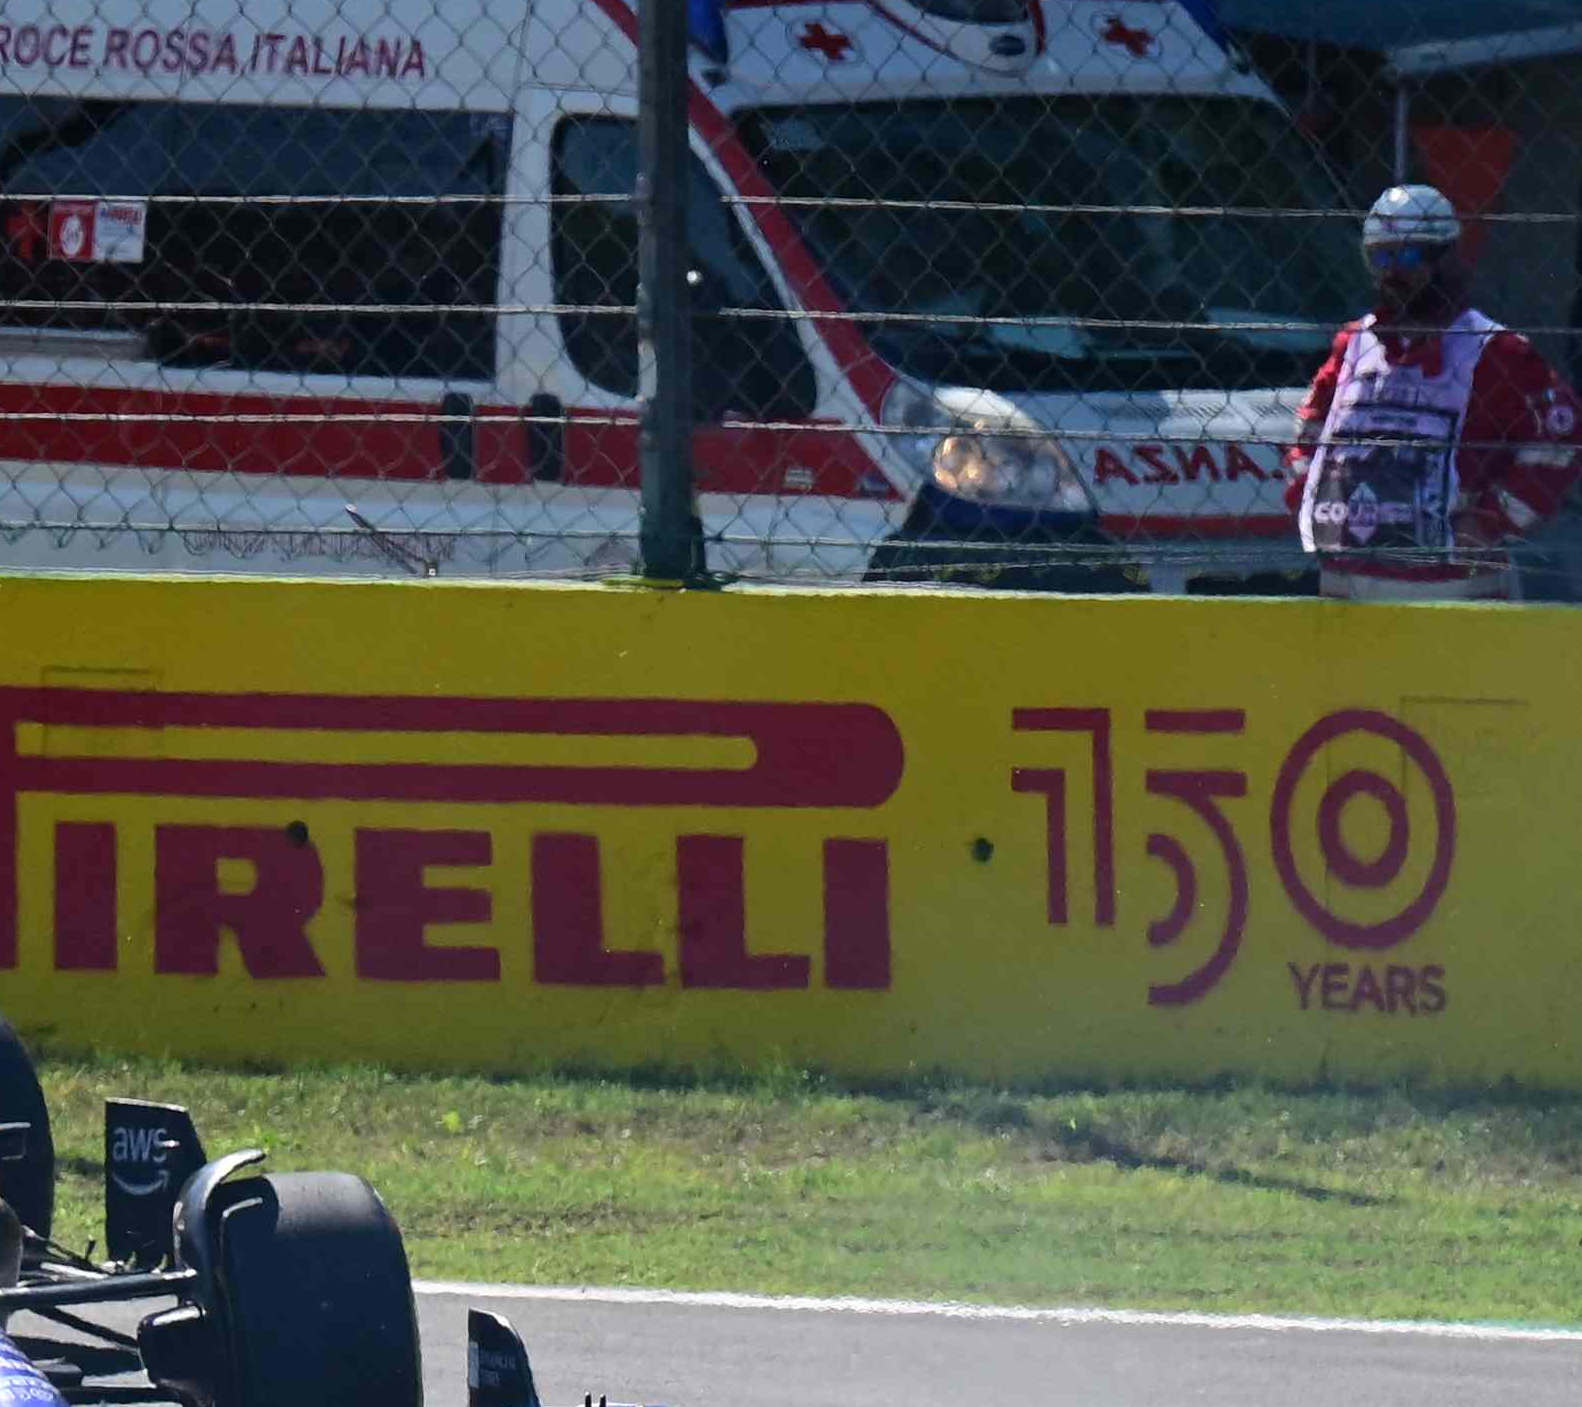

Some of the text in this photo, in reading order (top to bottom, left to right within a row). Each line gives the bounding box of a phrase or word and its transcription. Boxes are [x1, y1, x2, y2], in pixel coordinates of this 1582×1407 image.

[103, 28, 237, 74] ROSSA
[251, 33, 427, 79] ITALIANA
[1011, 706, 1456, 1005] 150
[1287, 960, 1447, 1014] YEARS
[113, 1127, 168, 1163] aws
